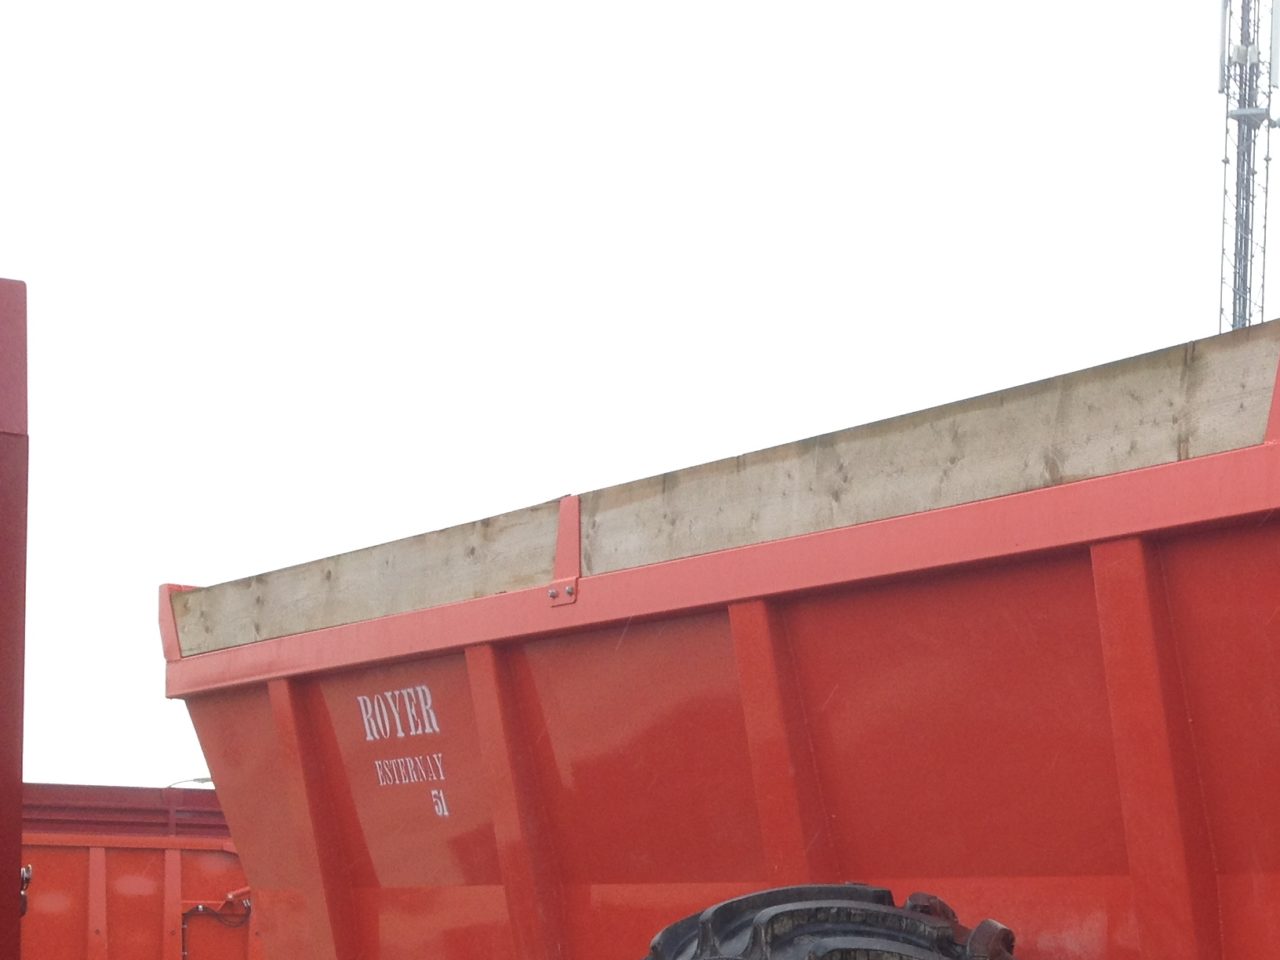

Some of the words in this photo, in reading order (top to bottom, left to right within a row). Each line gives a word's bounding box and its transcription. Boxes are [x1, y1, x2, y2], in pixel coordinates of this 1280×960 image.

[357, 684, 440, 741] ROYER
[375, 753, 445, 786] ESTERNAY
[431, 788, 449, 817] 51
